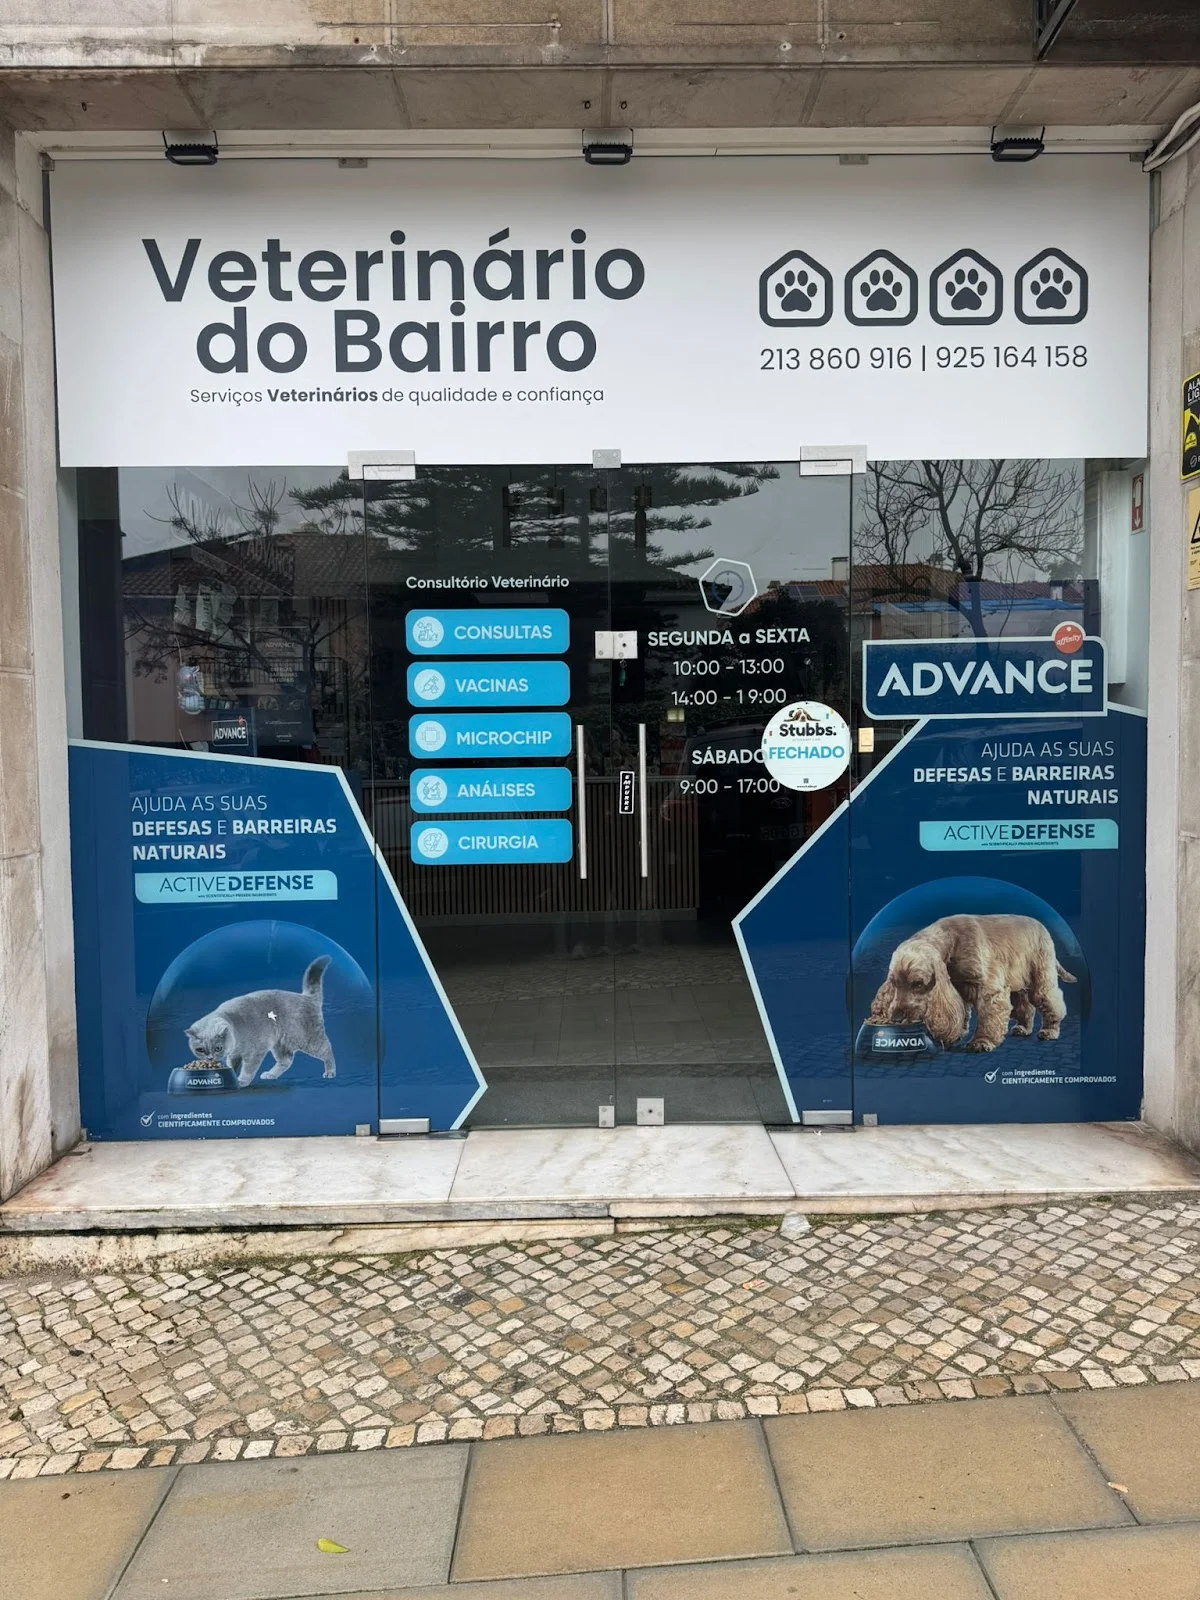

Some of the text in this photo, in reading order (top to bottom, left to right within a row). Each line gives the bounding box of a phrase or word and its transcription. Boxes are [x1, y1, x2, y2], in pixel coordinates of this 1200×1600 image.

[141, 226, 645, 302] Veterinário
[196, 301, 597, 373] do Bairro
[760, 348, 800, 370] 213
[809, 347, 861, 370] 860
[869, 346, 912, 369] 916
[936, 346, 985, 368] 925
[993, 345, 1037, 368] 164
[1044, 345, 1088, 367] 158
[190, 386, 604, 407] Serviços Veterinários de qualidade e confiança
[405, 574, 570, 589] Consultório Veterinário
[454, 625, 553, 640] CONSULTAS
[647, 628, 811, 647] SEGUNDA a SEXTA
[673, 660, 720, 676] 10:00
[739, 658, 785, 675] 13:00
[455, 678, 529, 693] VACINAS
[877, 659, 1093, 697] ADVANCE
[671, 689, 718, 706] 14:00
[214, 726, 247, 740] ADVANCE
[456, 730, 553, 746] MICROCHIP
[779, 722, 837, 737] Stubbs.
[768, 745, 845, 760] FECHADO
[981, 740, 1115, 761] AJUDA AS SUAS
[913, 764, 1115, 783] DEFESAS E BARREIRAS
[456, 780, 536, 798] ANÁLISES
[623, 774, 631, 811] EMPURRE
[679, 779, 718, 795] 9:00
[737, 778, 781, 793] 17:00
[131, 795, 268, 815] AJUDA AS SUAS
[1027, 789, 1119, 805] NATURAIS
[132, 818, 337, 837] DEFESAS E BARREIRAS
[943, 823, 1096, 841] ACTIVEDEFENSE
[457, 835, 539, 850] CIRURGIA
[132, 844, 227, 861] NATURAIS
[159, 874, 314, 893] ACTIVEDEFENSE
[187, 1077, 223, 1086] ADVANCE
[1001, 1075, 1117, 1085] CIENTIFICAMENTE COMPROVADOS
[1014, 1069, 1056, 1077] ingredientes
[157, 1118, 276, 1128] CIENTIFICAMENTE COMPROVADOS
[170, 1112, 213, 1121] ingredientes
